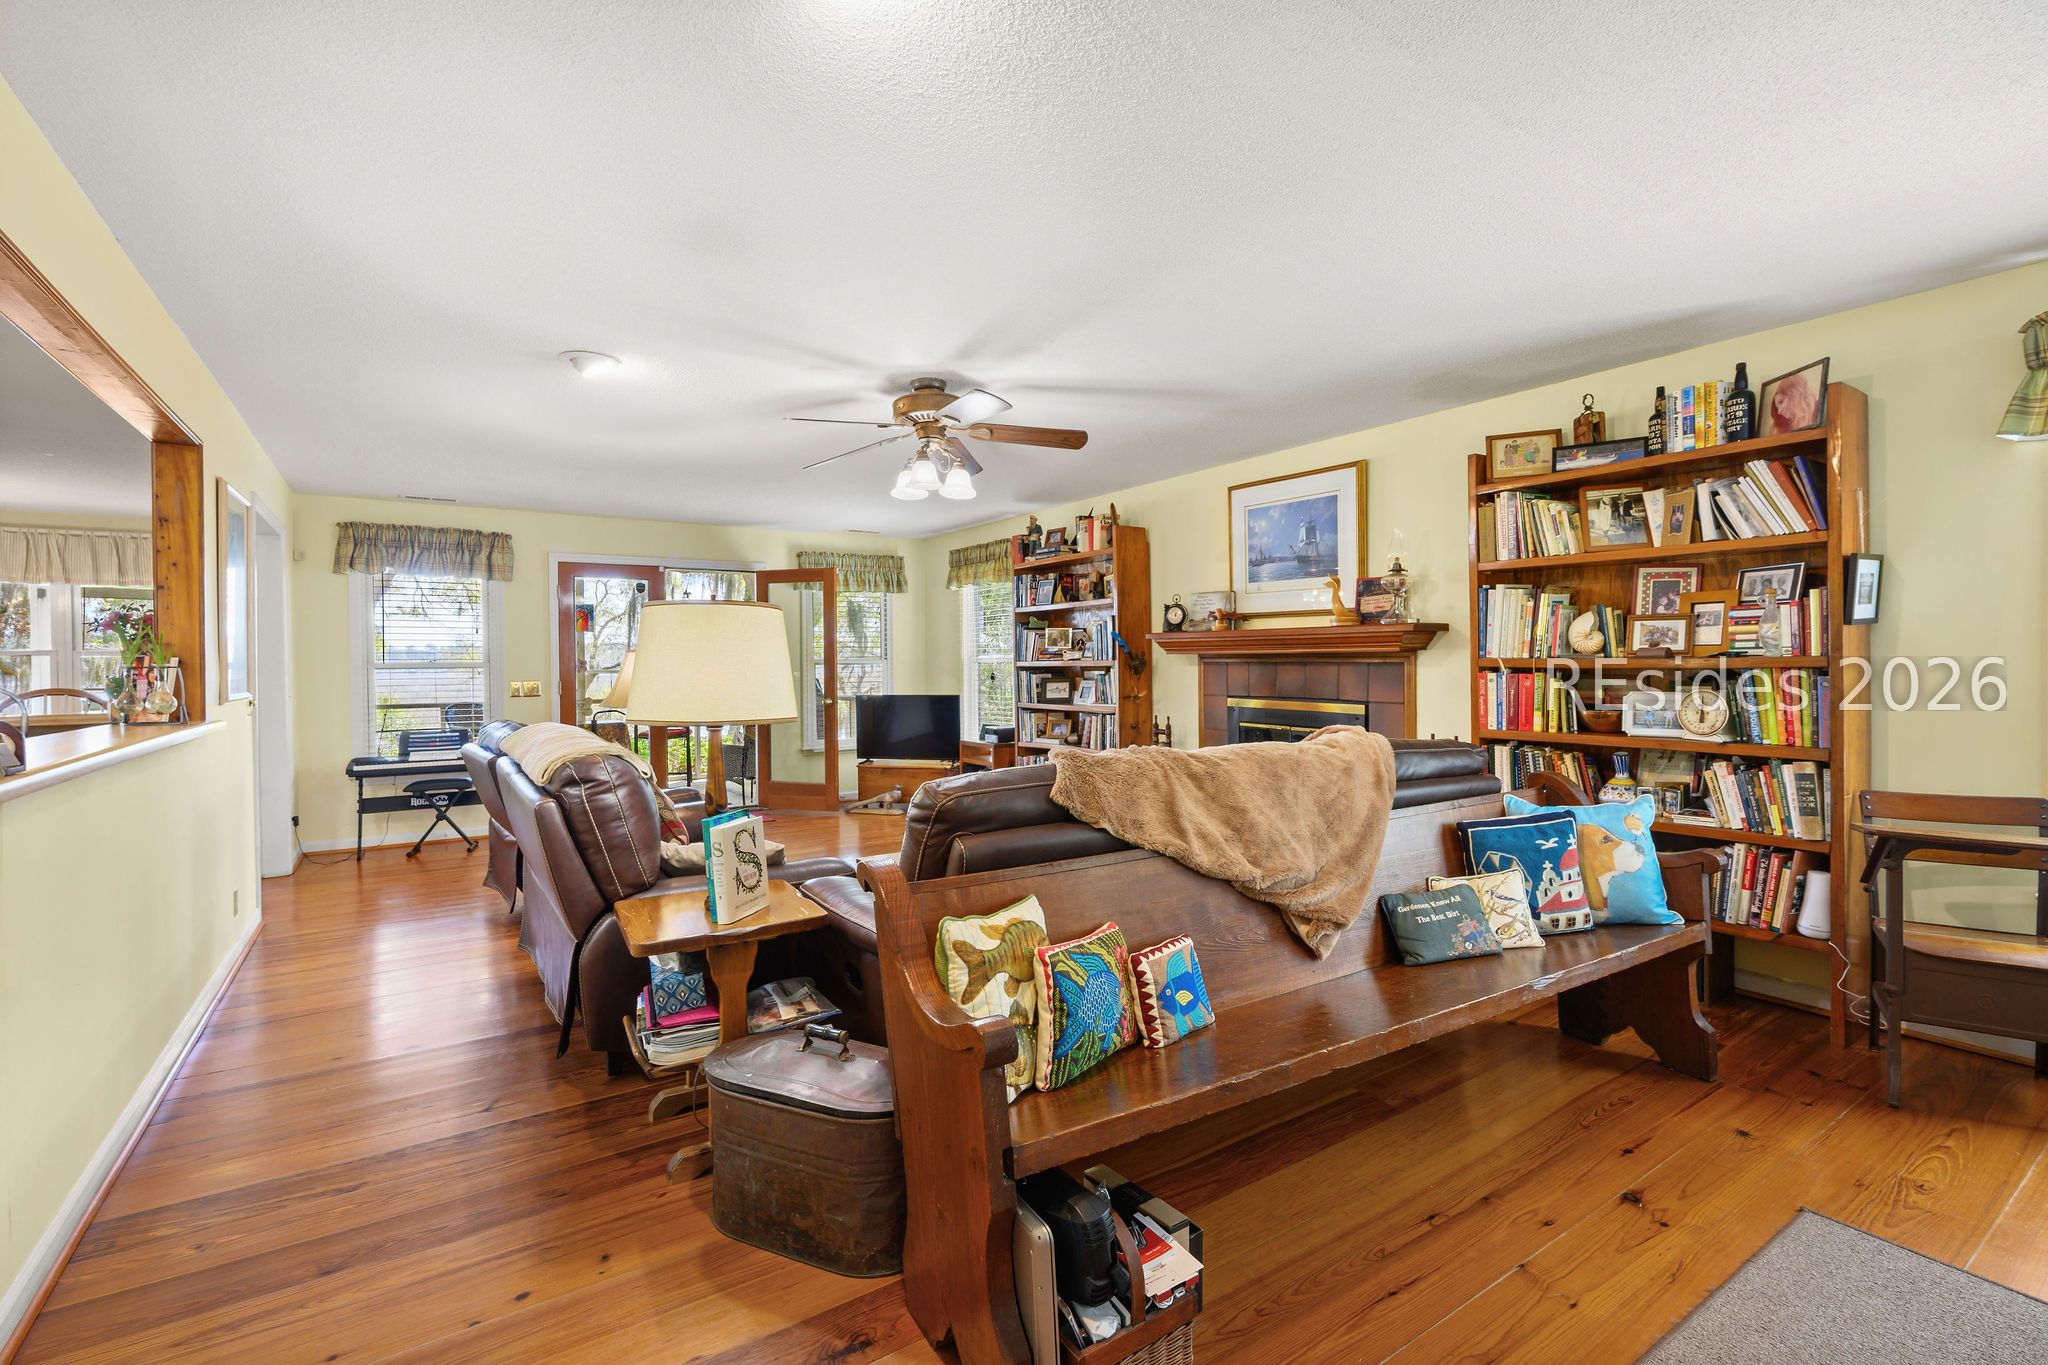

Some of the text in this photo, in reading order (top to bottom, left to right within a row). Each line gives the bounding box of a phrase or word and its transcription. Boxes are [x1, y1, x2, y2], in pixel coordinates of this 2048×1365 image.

[1750, 714, 1759, 736] SOUTH
[712, 842, 724, 858] S
[733, 825, 762, 896] S
[1430, 898, 1450, 909] Know
[1450, 895, 1461, 904] All
[1416, 908, 1460, 924] The Best Dirt
